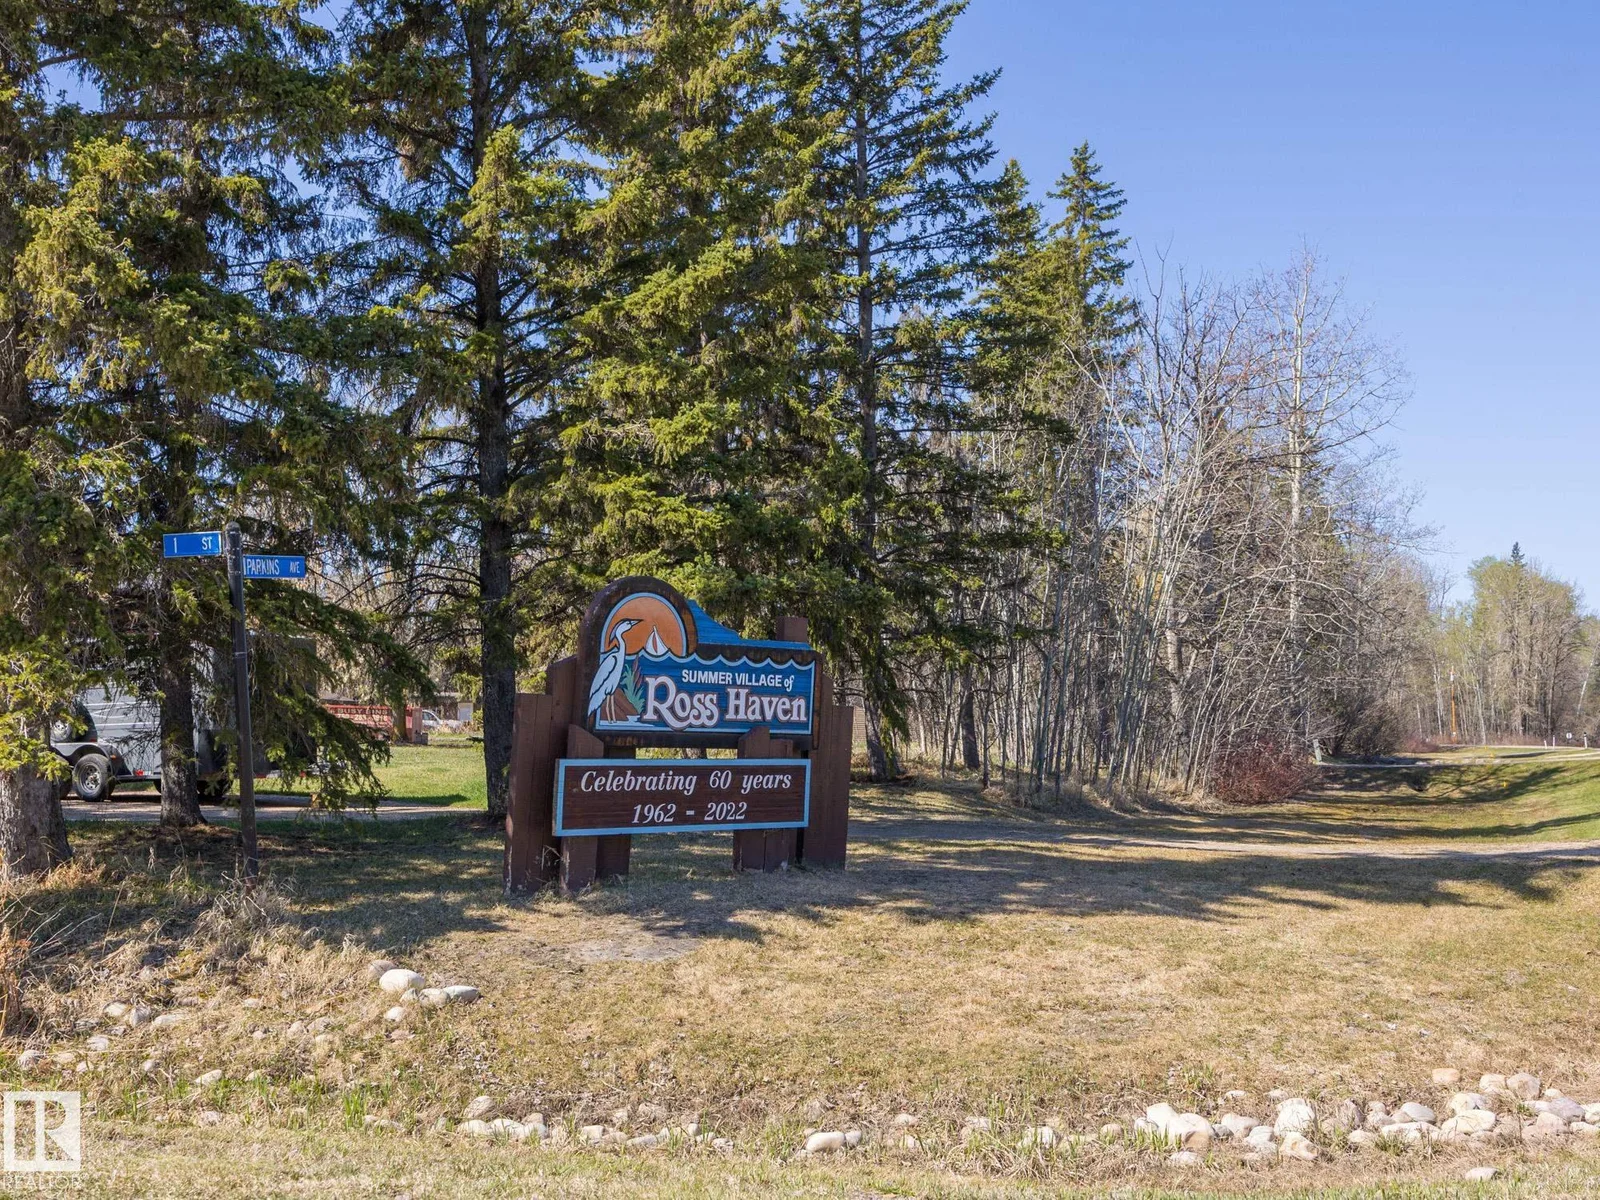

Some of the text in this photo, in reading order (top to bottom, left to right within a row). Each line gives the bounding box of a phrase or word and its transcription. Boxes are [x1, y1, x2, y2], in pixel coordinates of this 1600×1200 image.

[173, 536, 213, 554] 1 ST
[246, 558, 300, 576] PARKINS AVE
[682, 669, 795, 692] SUMMER VILLAGE of
[643, 675, 808, 728] Ross Haven
[580, 769, 792, 796] Celebrating 60 years
[632, 803, 677, 824] 1962
[704, 801, 747, 821] 2022
